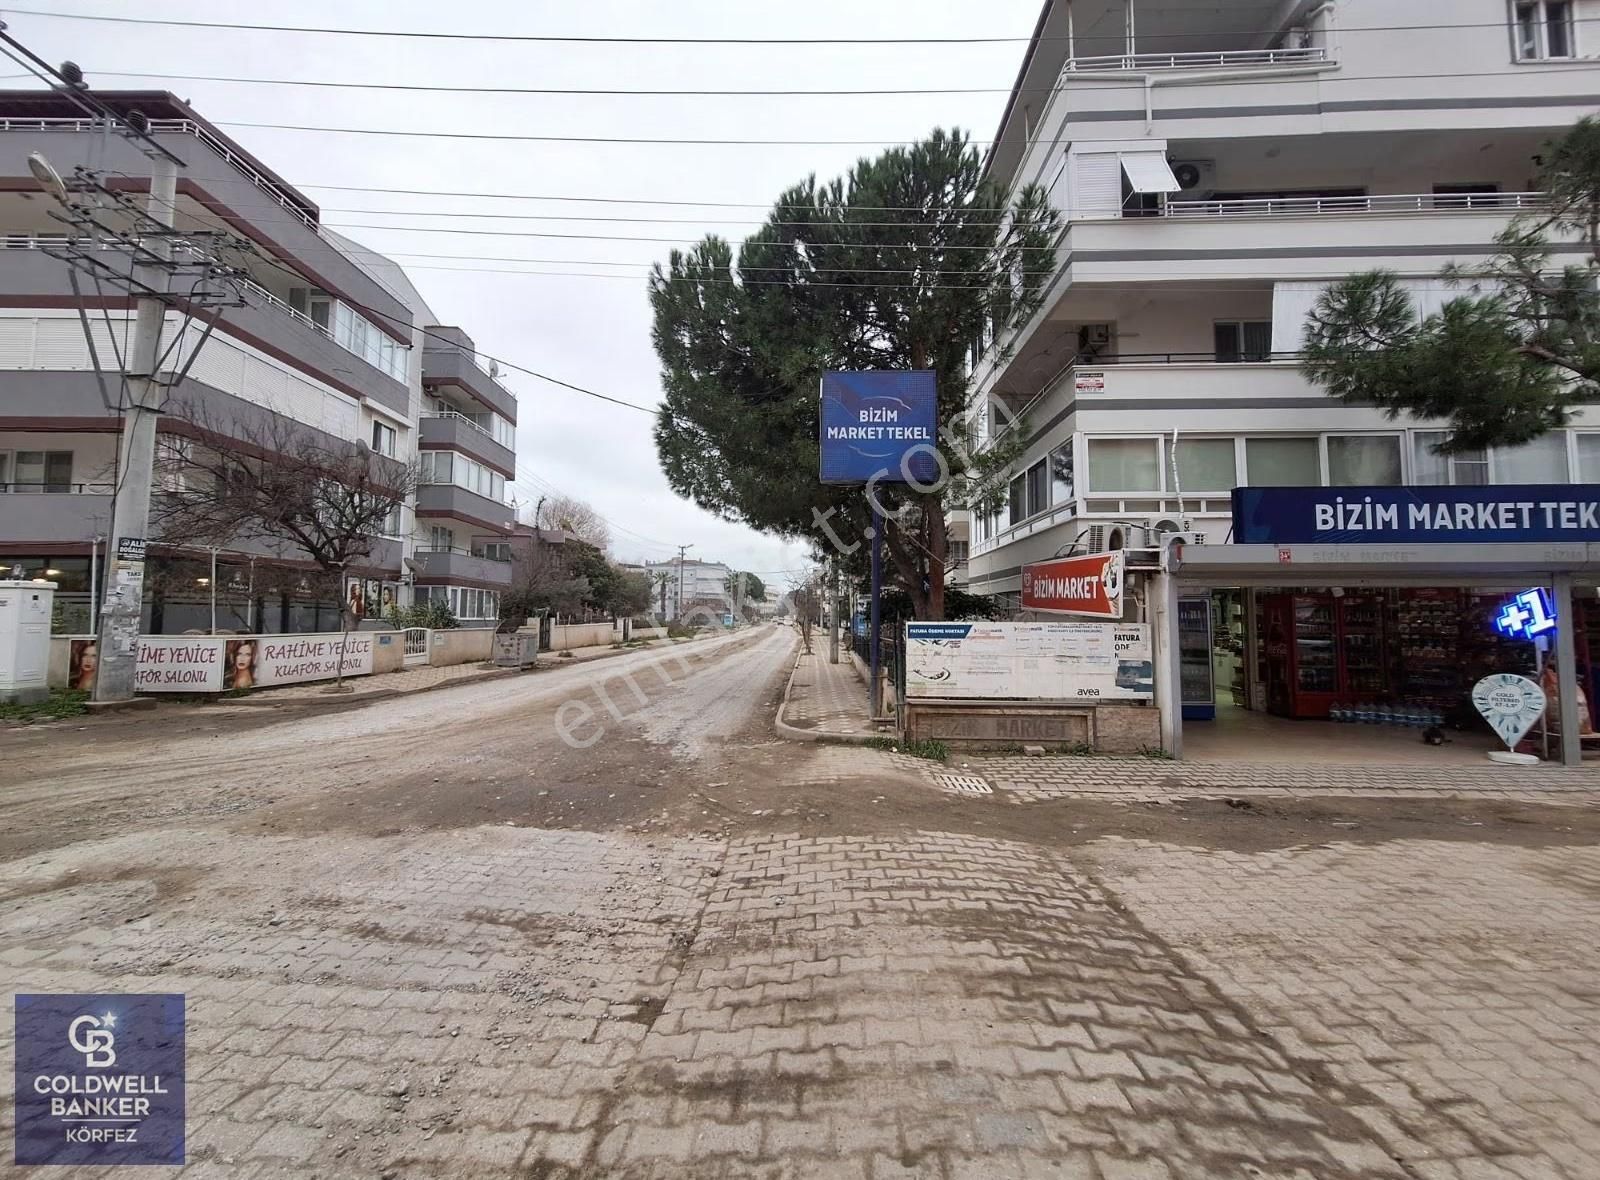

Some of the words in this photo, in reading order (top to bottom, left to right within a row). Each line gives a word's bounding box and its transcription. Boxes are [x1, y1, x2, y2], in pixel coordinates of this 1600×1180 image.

[859, 407, 898, 422] BİZİM
[827, 426, 885, 440] MARKET
[886, 426, 931, 440] TEKEL
[1314, 496, 1399, 531] BİZİM
[1407, 502, 1534, 530] MARKET
[1033, 574, 1055, 599] BİZİM
[1056, 575, 1099, 599] MARKET
[1114, 634, 1140, 642] FATURA
[169, 643, 218, 664] YENİCE
[264, 640, 326, 661] RAHİME
[328, 637, 370, 656] YENİCE
[164, 669, 208, 684] SALONU
[274, 661, 321, 678] KUAFÖR
[323, 658, 362, 673] SALONU
[1077, 688, 1100, 696] avea
